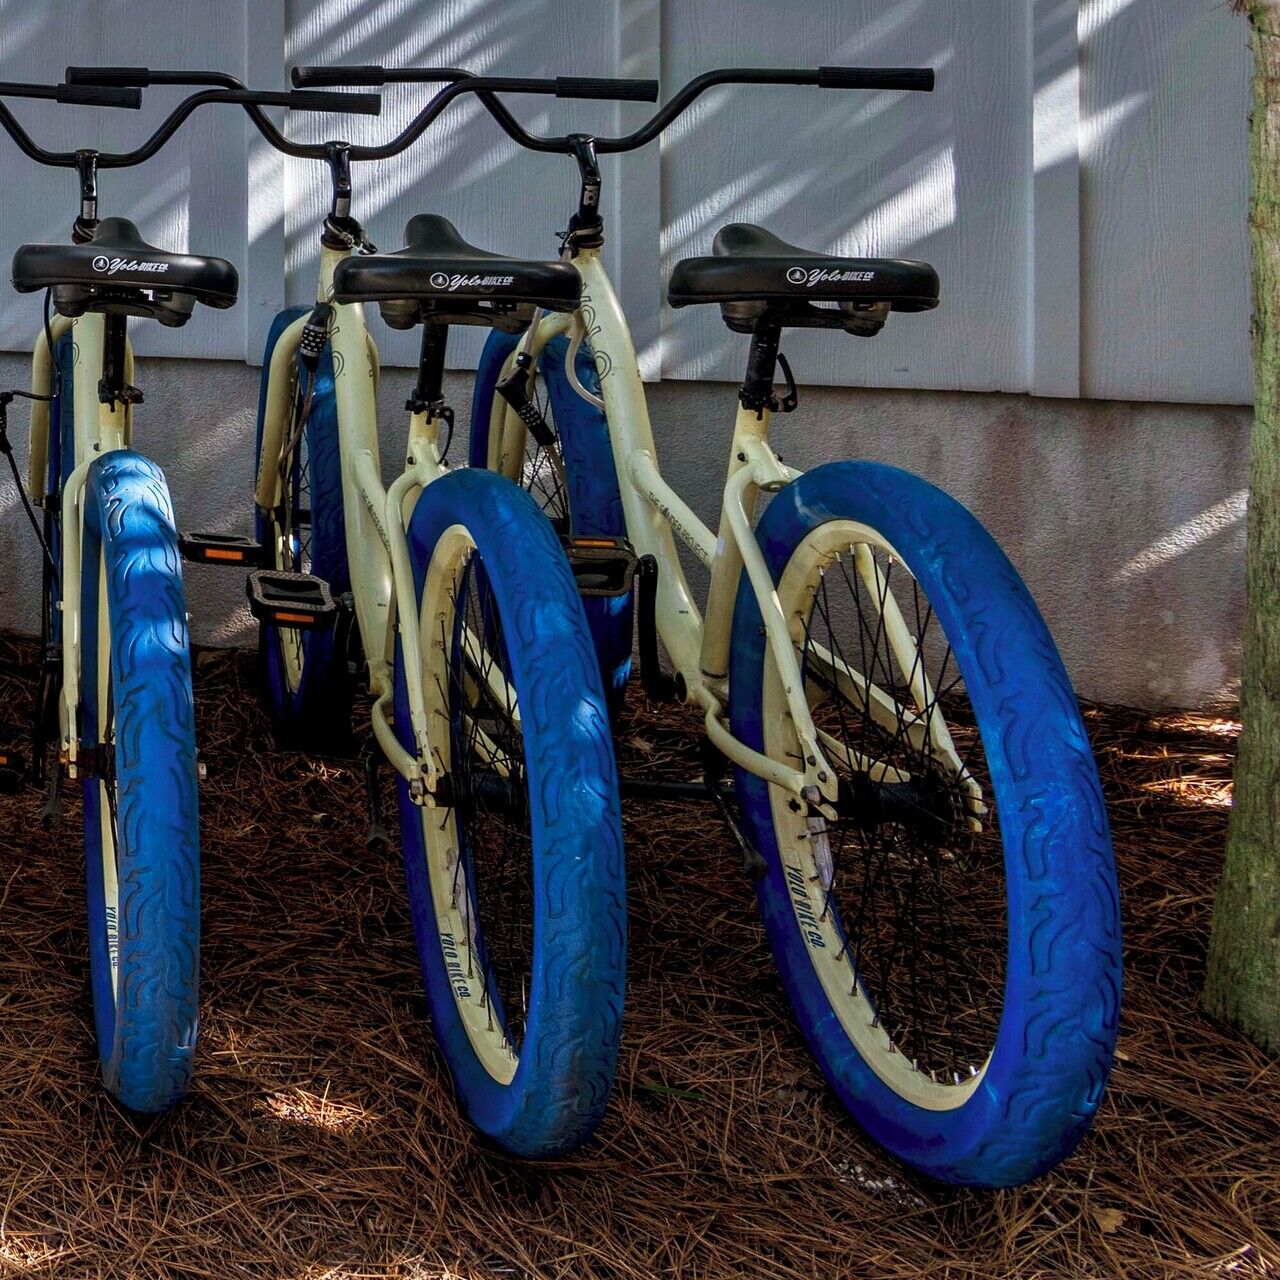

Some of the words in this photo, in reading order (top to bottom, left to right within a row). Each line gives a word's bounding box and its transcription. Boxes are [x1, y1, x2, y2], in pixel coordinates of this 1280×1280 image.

[786, 865, 808, 898] YOLO
[793, 900, 819, 930] BIKE
[440, 933, 458, 958] YOLO
[447, 962, 466, 984] BIKE
